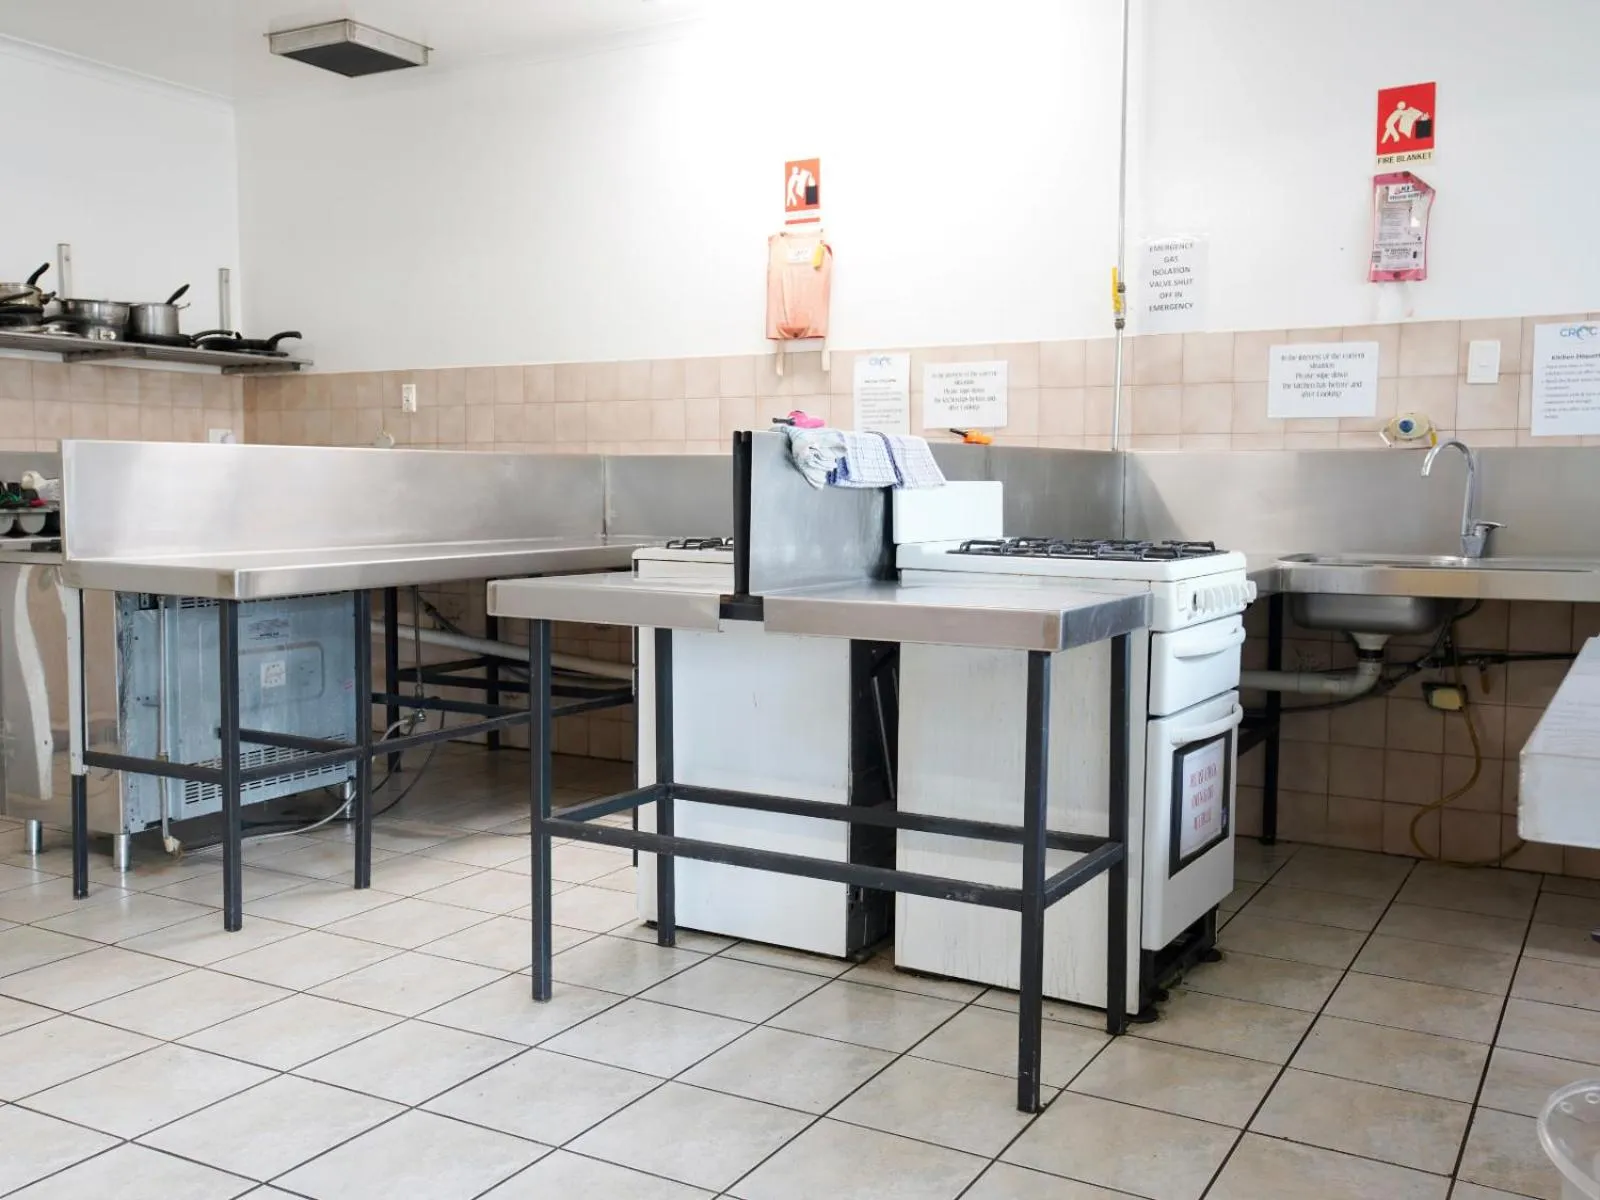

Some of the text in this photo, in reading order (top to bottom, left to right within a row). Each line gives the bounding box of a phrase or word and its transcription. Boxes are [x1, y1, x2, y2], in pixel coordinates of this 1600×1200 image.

[1377, 152, 1432, 165] FIRE BLANKET
[1149, 243, 1194, 252] EMERGENCY
[1152, 267, 1191, 276] ISOLATION
[1149, 278, 1194, 288] VALVE SHUT
[1149, 303, 1194, 312] EMERGENCY
